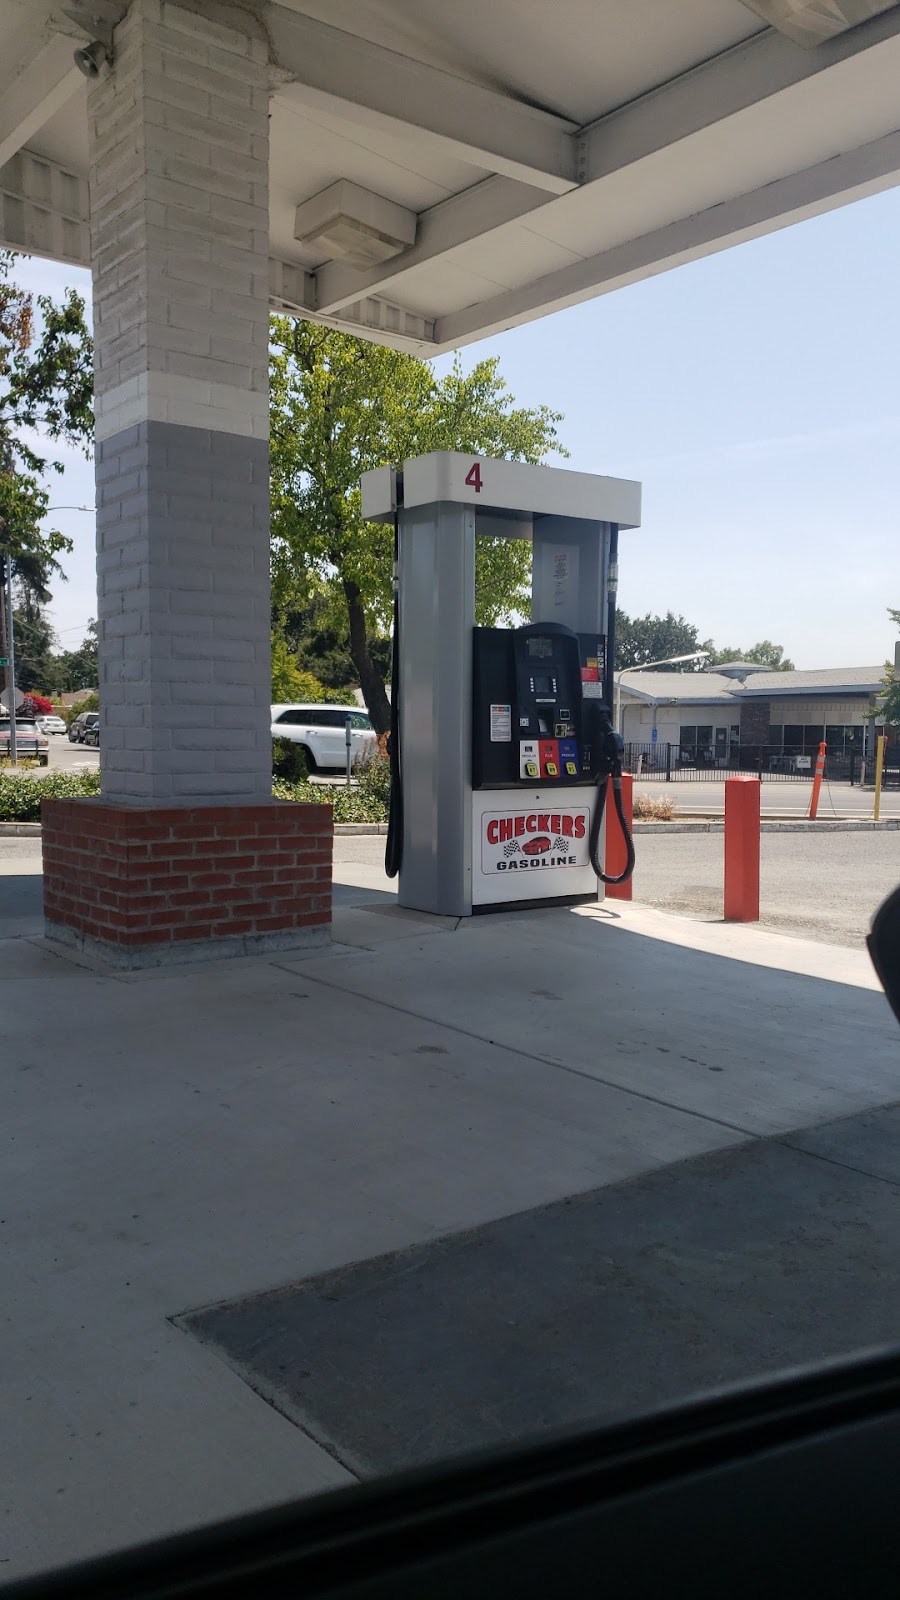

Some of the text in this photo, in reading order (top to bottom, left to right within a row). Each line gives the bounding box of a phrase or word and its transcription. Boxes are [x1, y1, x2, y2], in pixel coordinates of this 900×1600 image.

[465, 462, 483, 493] 4
[487, 814, 586, 845] CHECKERS
[496, 855, 577, 871] GASOLINE
